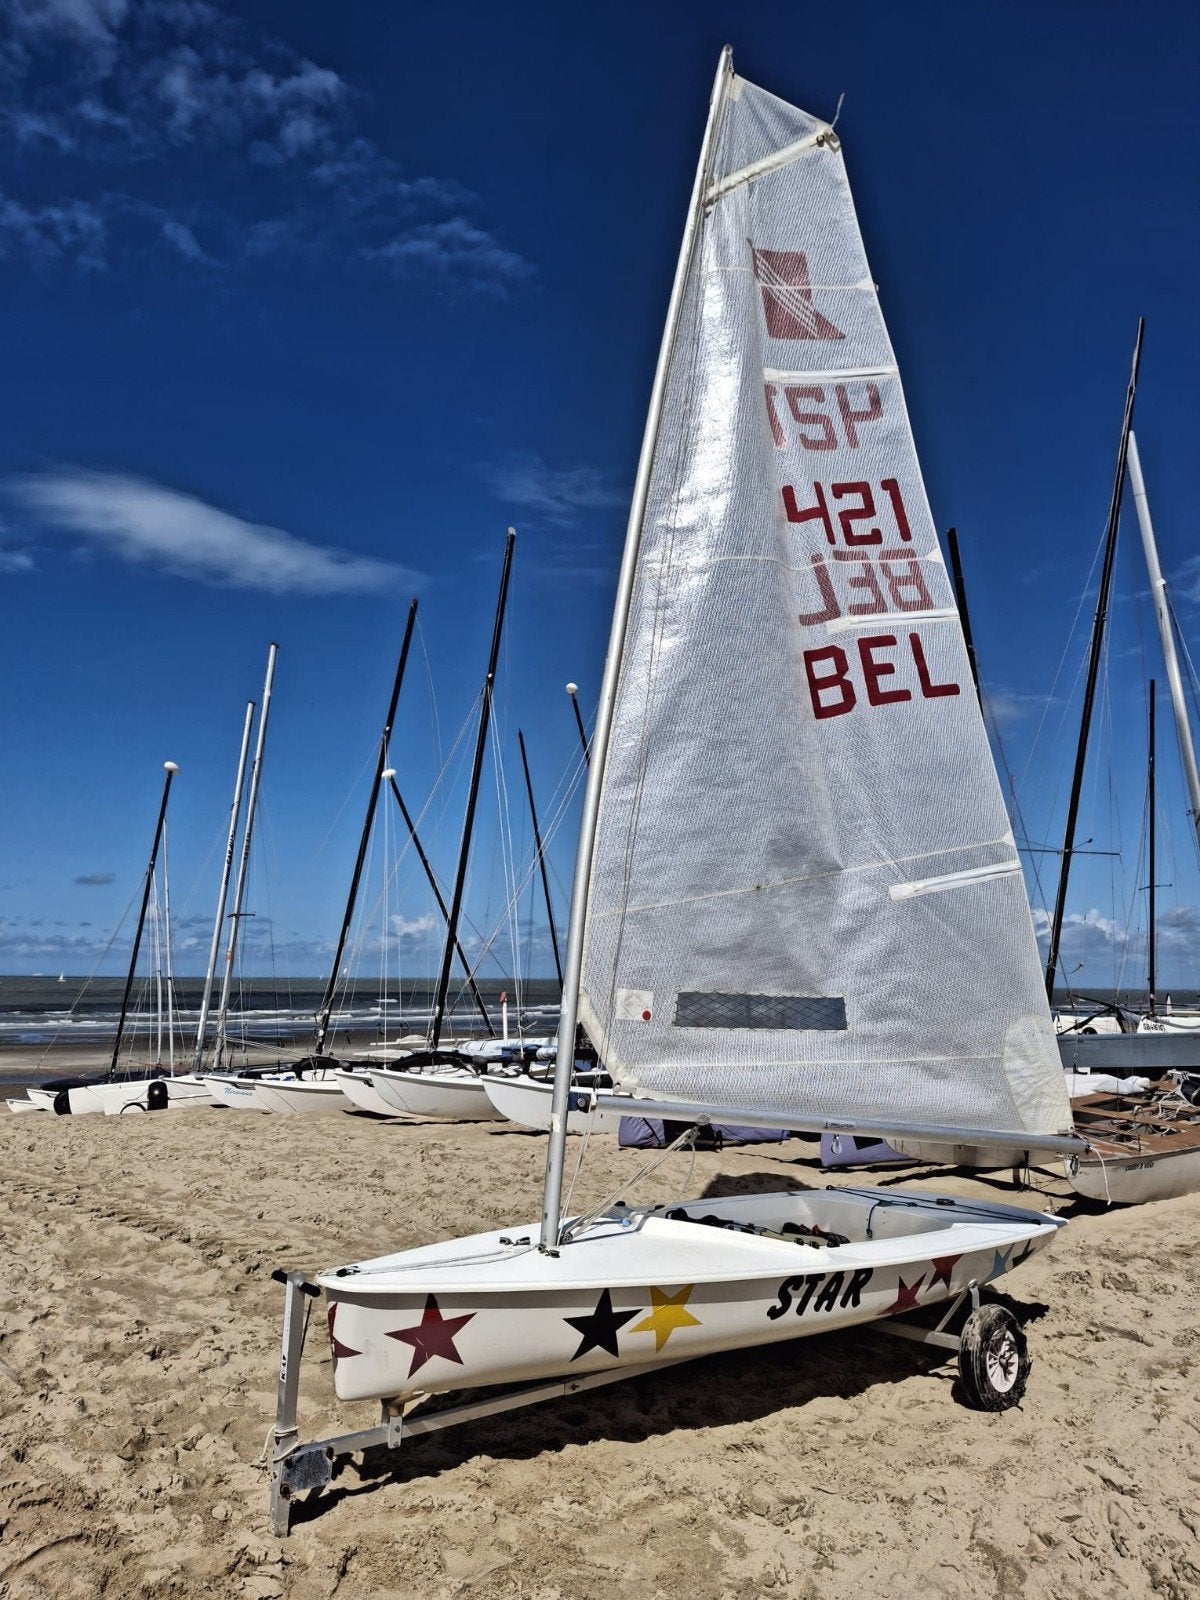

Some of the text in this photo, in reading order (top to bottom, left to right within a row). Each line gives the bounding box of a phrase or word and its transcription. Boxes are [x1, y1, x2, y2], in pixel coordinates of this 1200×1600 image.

[782, 478, 912, 547] 421
[803, 632, 961, 720] BEL
[766, 1267, 874, 1321] STAR
